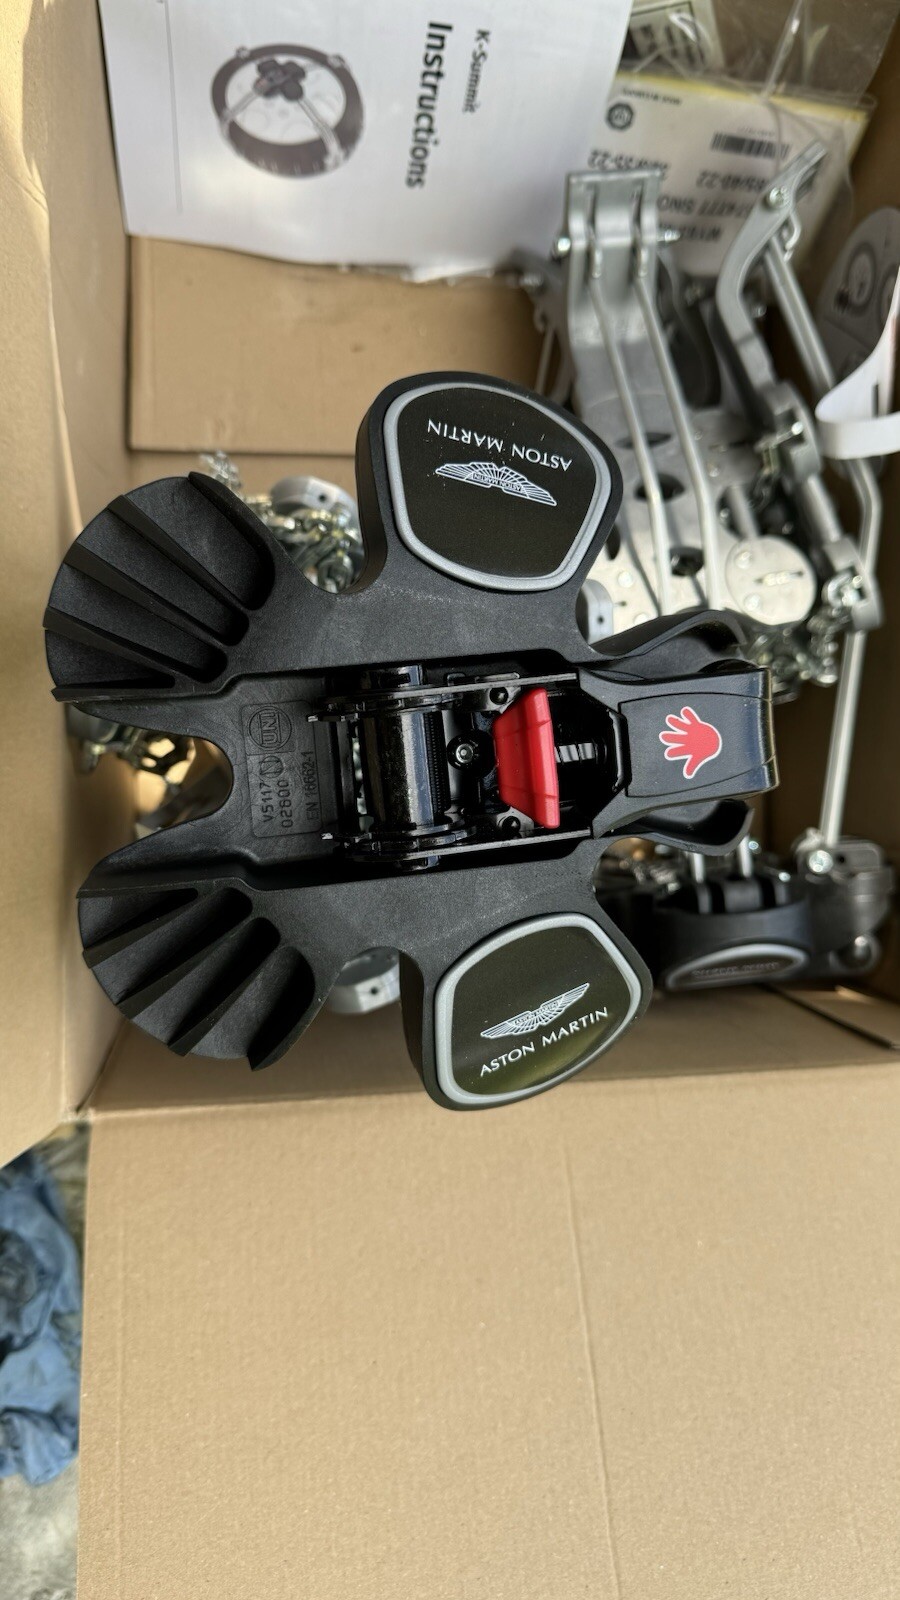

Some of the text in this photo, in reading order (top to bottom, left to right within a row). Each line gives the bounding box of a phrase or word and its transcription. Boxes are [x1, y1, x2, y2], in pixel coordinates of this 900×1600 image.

[405, 21, 454, 189] Instructions
[427, 418, 573, 472] ASTON MARTIN
[262, 714, 278, 743] UNI
[277, 779, 293, 828] 02600
[302, 751, 318, 820] EN 16662-1
[480, 1006, 609, 1078] ASTON MARTIN
